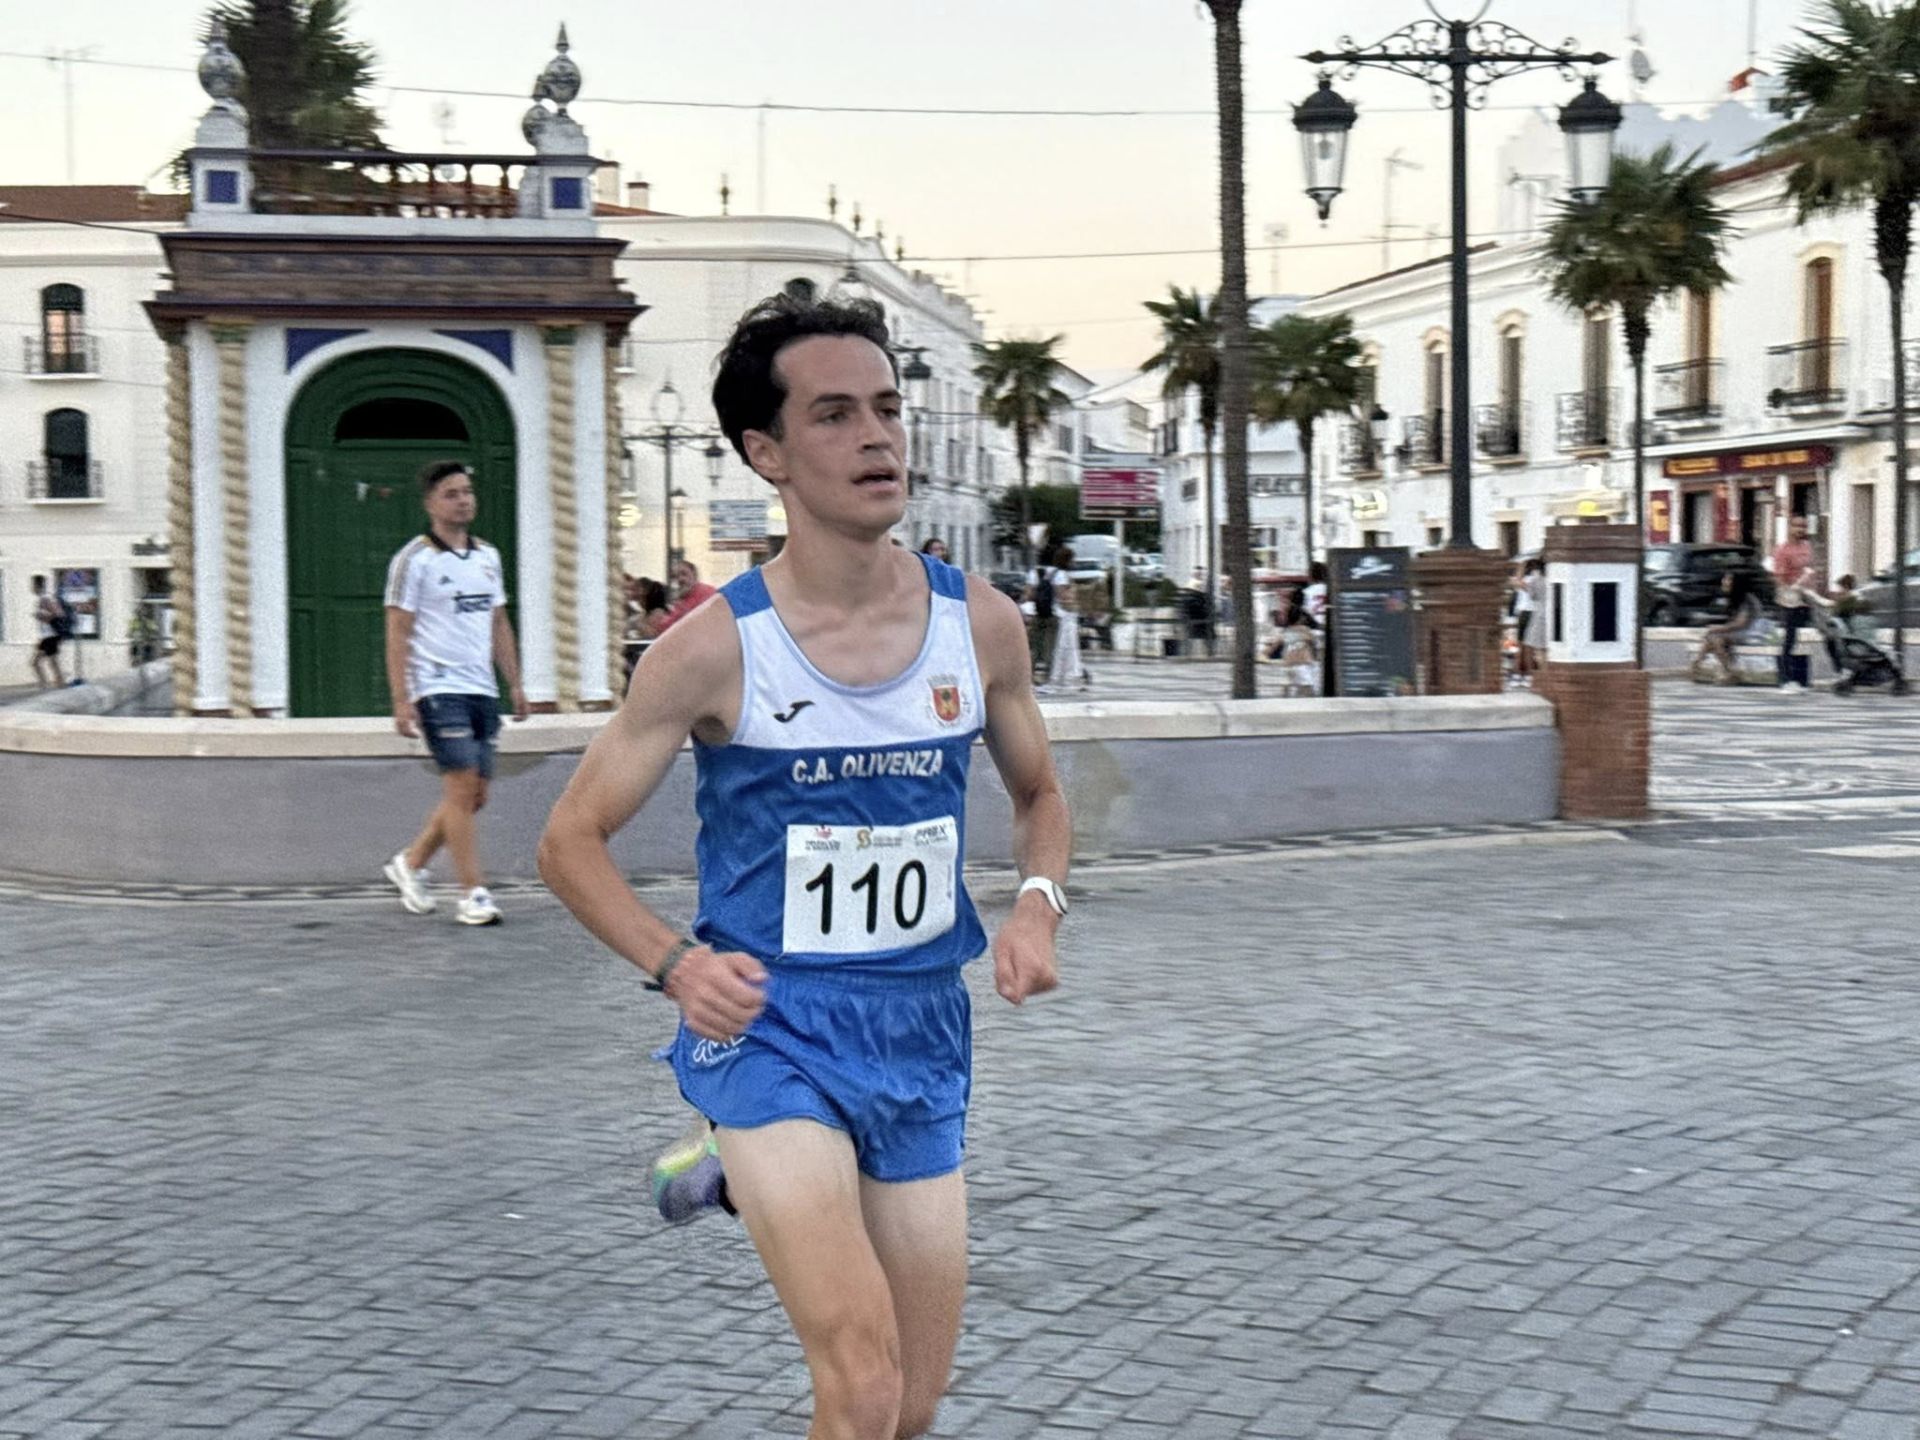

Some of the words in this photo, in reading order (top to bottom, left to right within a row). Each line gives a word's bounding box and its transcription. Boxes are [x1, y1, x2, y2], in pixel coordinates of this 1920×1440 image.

[792, 757, 834, 784] C.A.
[840, 749, 944, 778] OLIVENZA
[805, 860, 927, 935] 110
